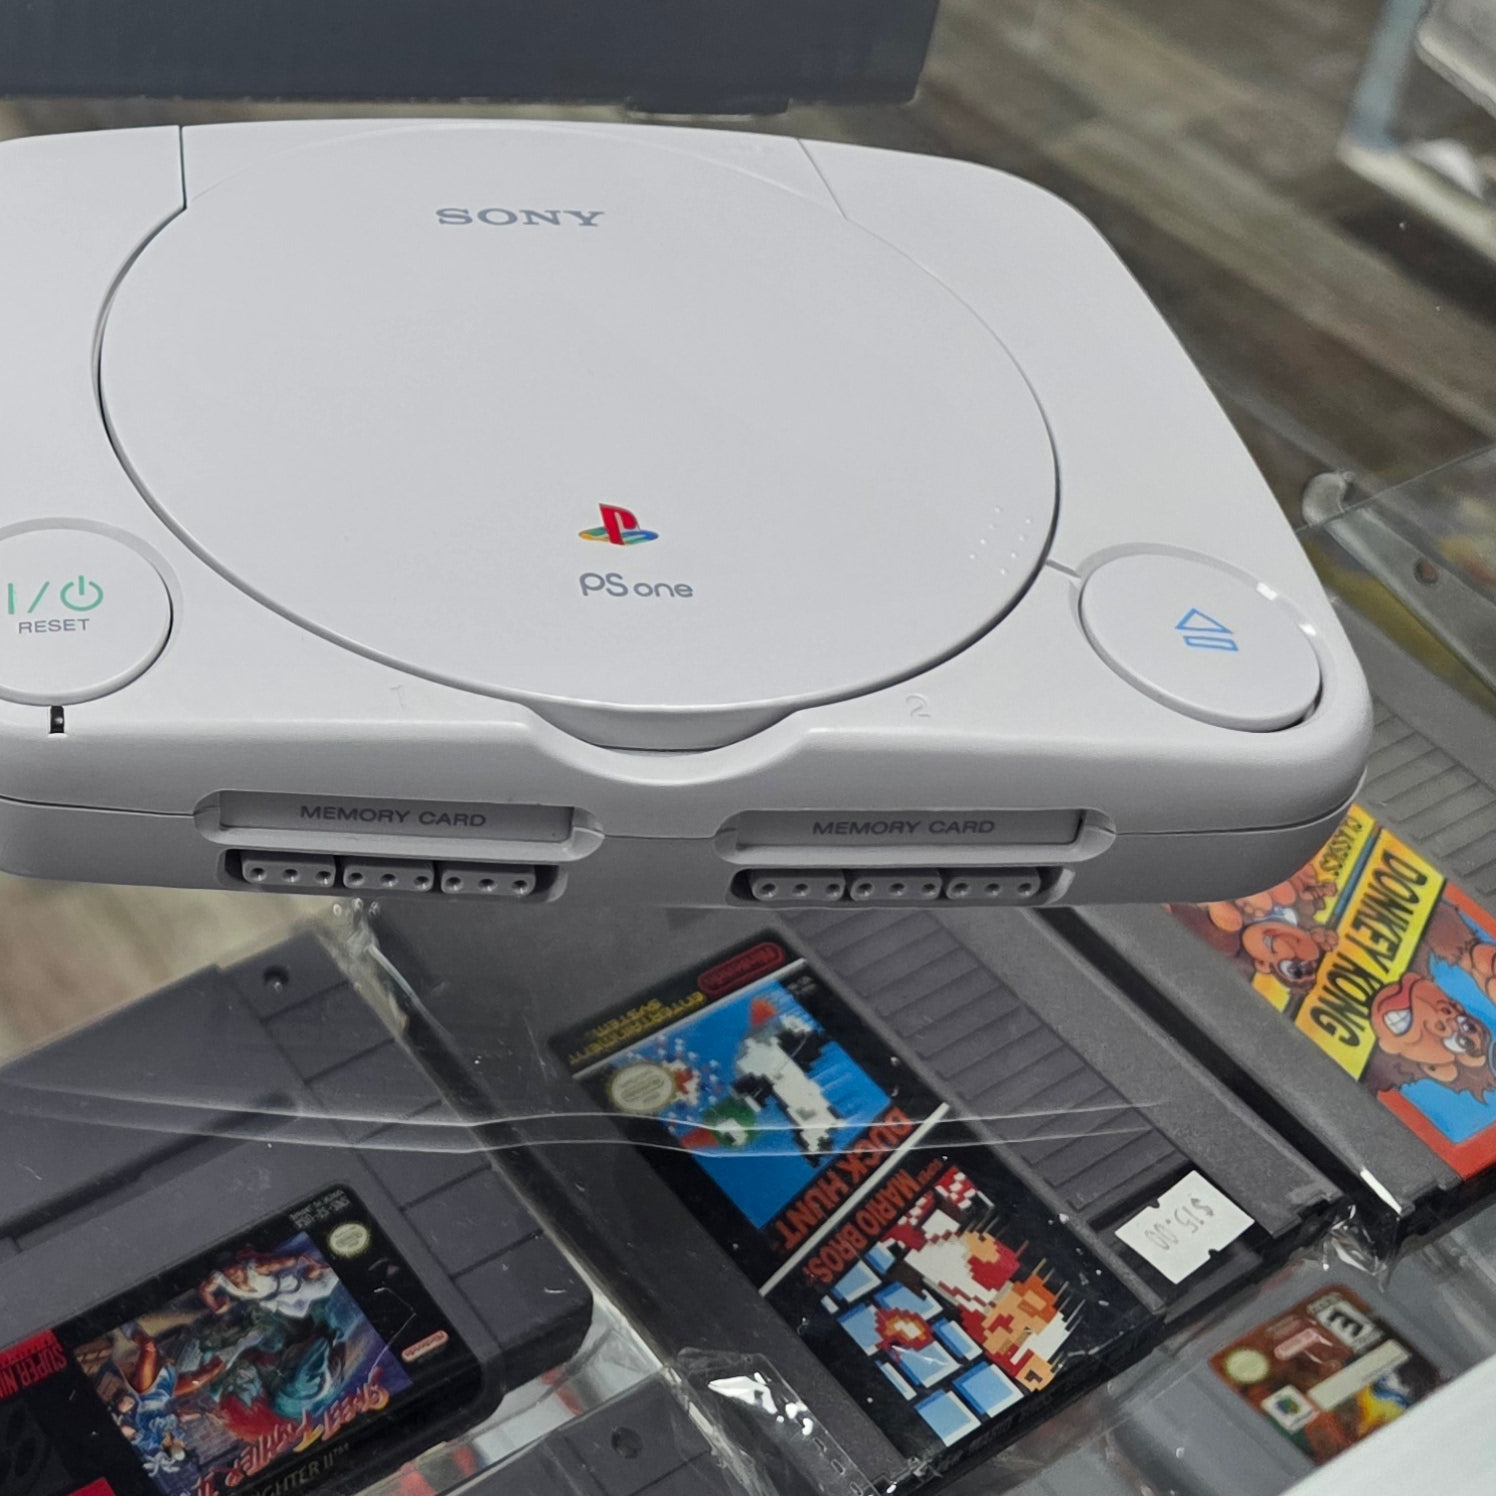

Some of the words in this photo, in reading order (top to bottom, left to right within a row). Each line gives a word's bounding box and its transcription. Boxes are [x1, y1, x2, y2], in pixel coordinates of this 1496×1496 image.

[435, 207, 605, 227] SONY
[579, 572, 629, 597] PS
[633, 582, 694, 598] one
[18, 618, 90, 634] RESET
[300, 805, 411, 823] MEMORY
[418, 810, 487, 827] CARD
[812, 820, 922, 836] MEMORY
[928, 819, 996, 835] CARD
[1317, 814, 1363, 878] CLASSICS
[1344, 848, 1429, 976] DONKEY
[1309, 951, 1386, 1048] KONG
[835, 1106, 913, 1184] DUCK
[774, 1168, 850, 1251] HUNT
[855, 1168, 921, 1237] MARIO
[1143, 1196, 1215, 1251] $15.00
[16, 1344, 68, 1387] SUPER
[321, 1366, 391, 1442] STREET
[224, 1408, 324, 1489] FIGHTER
